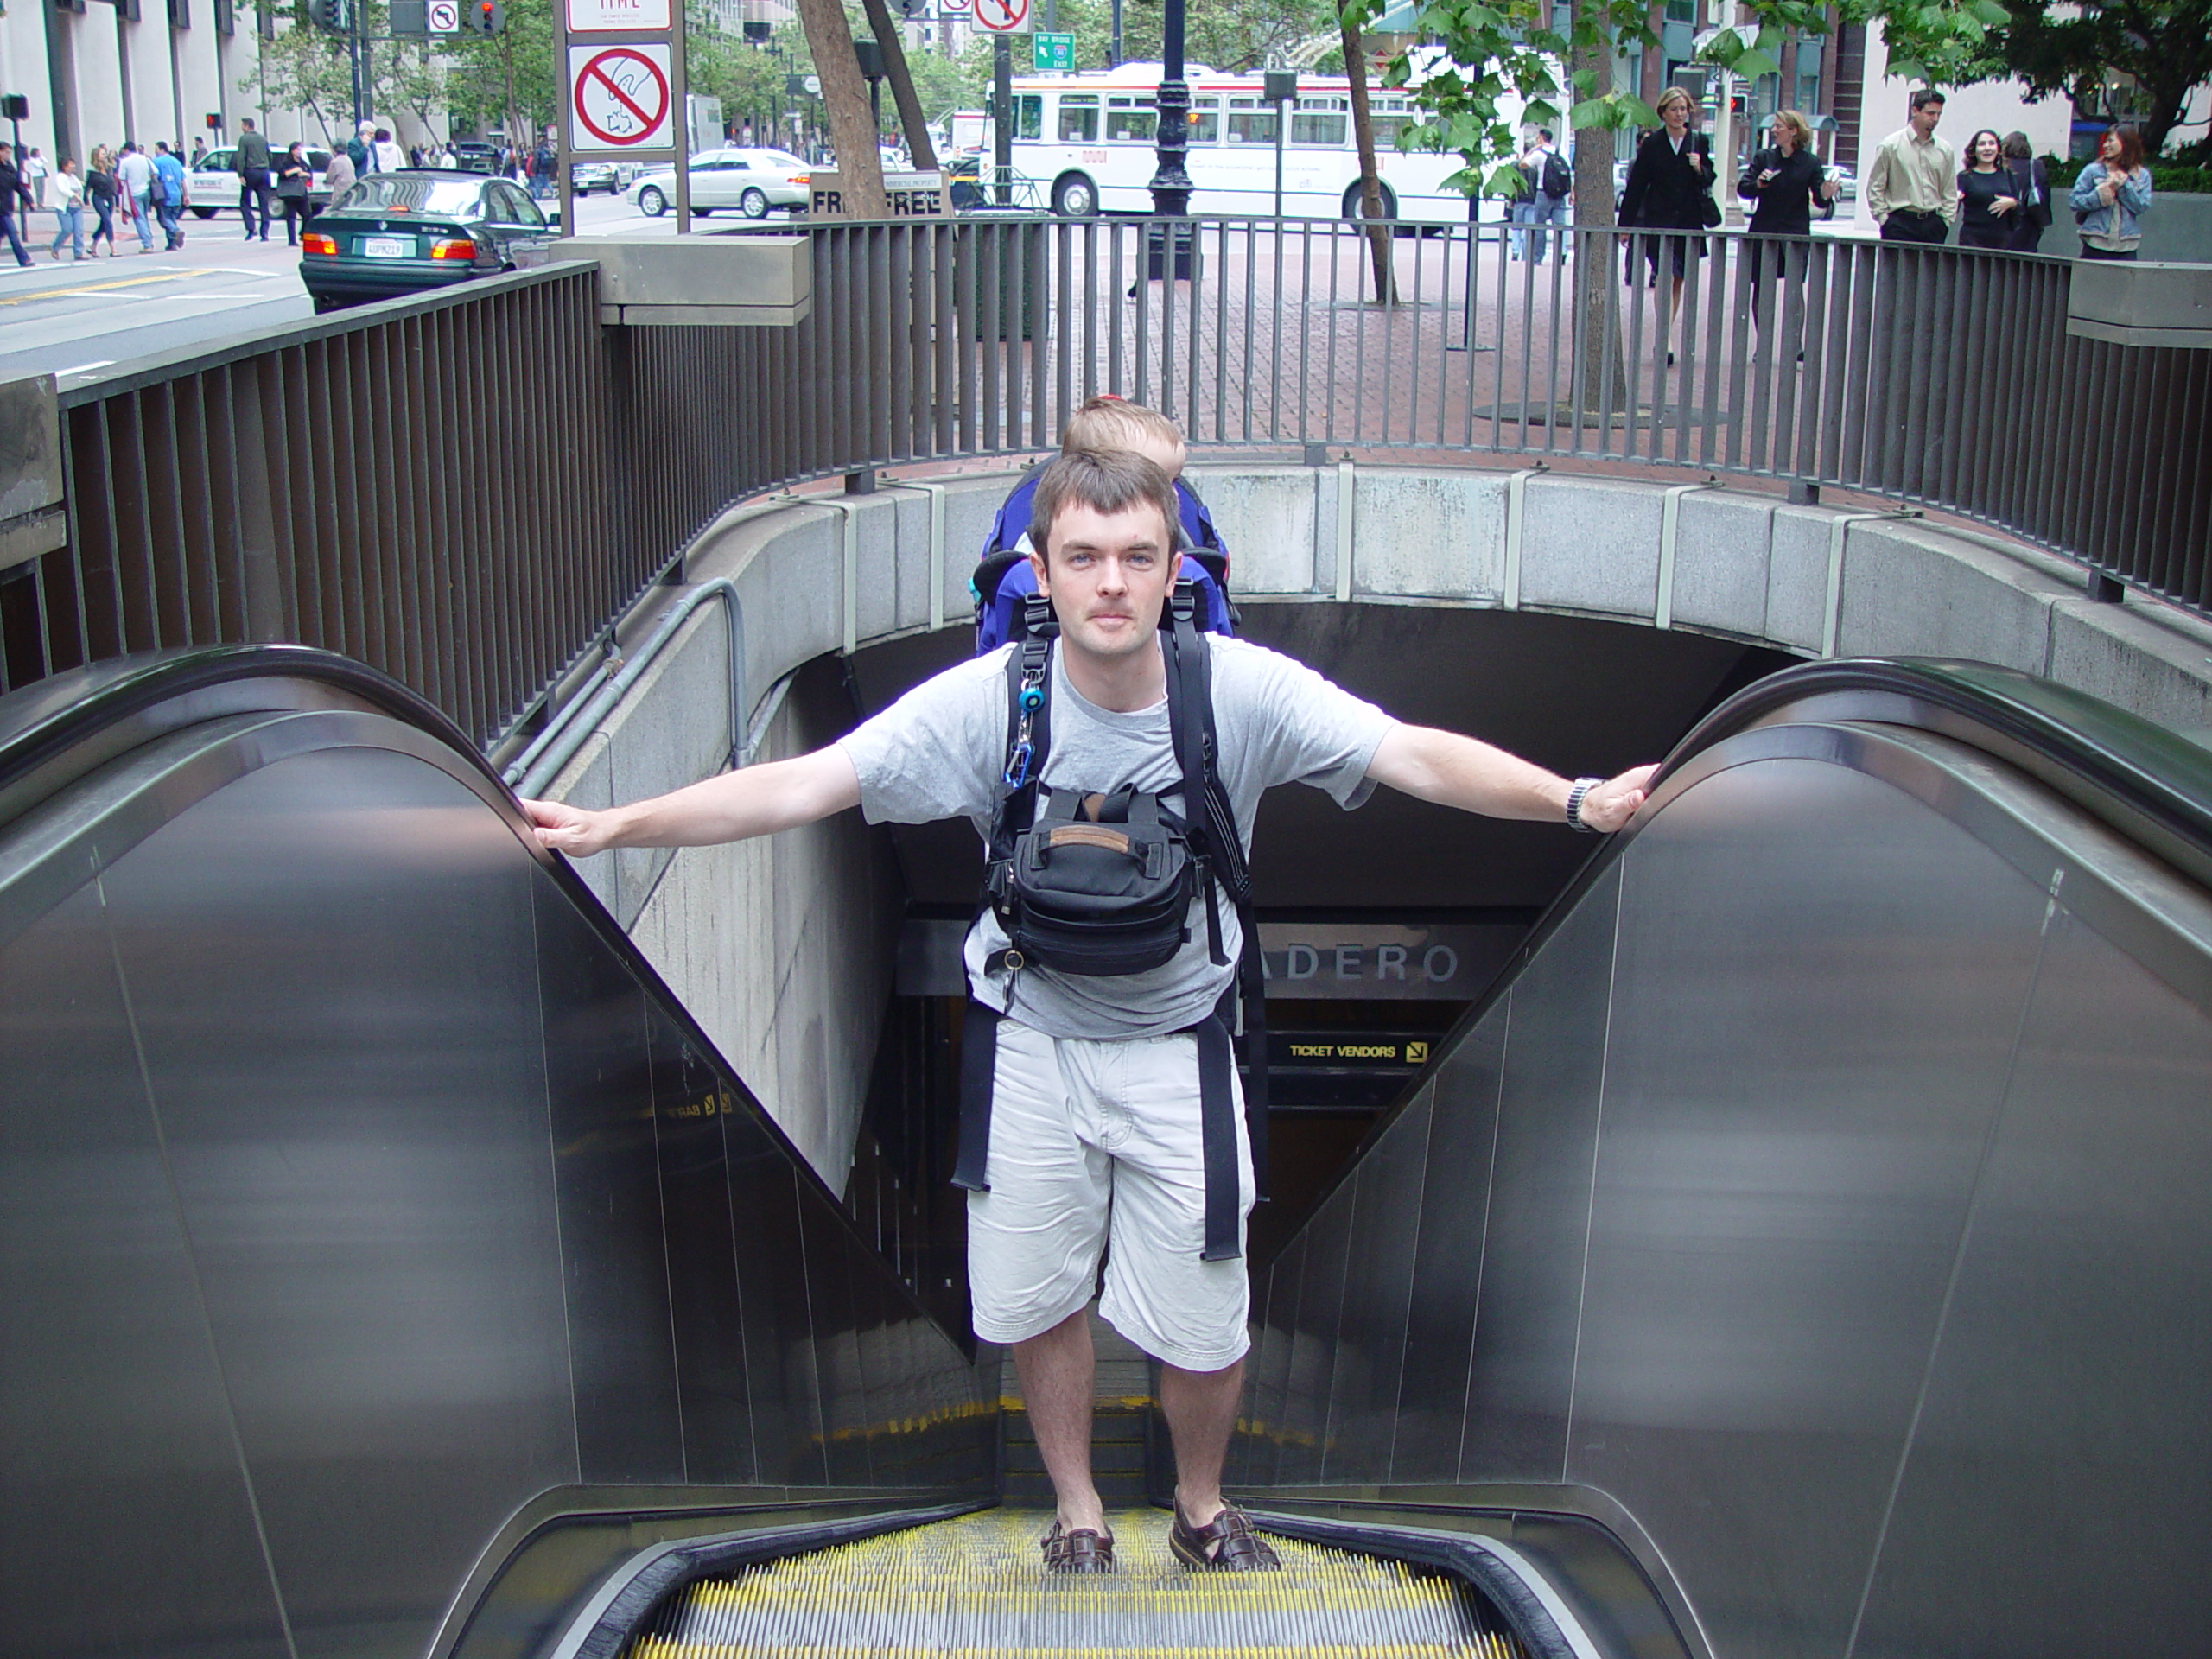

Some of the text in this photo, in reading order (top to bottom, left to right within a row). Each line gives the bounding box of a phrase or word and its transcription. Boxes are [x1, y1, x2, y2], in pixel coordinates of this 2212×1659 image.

[813, 190, 845, 214] FR
[1289, 1044, 1396, 1058] TICKET VENDORS
